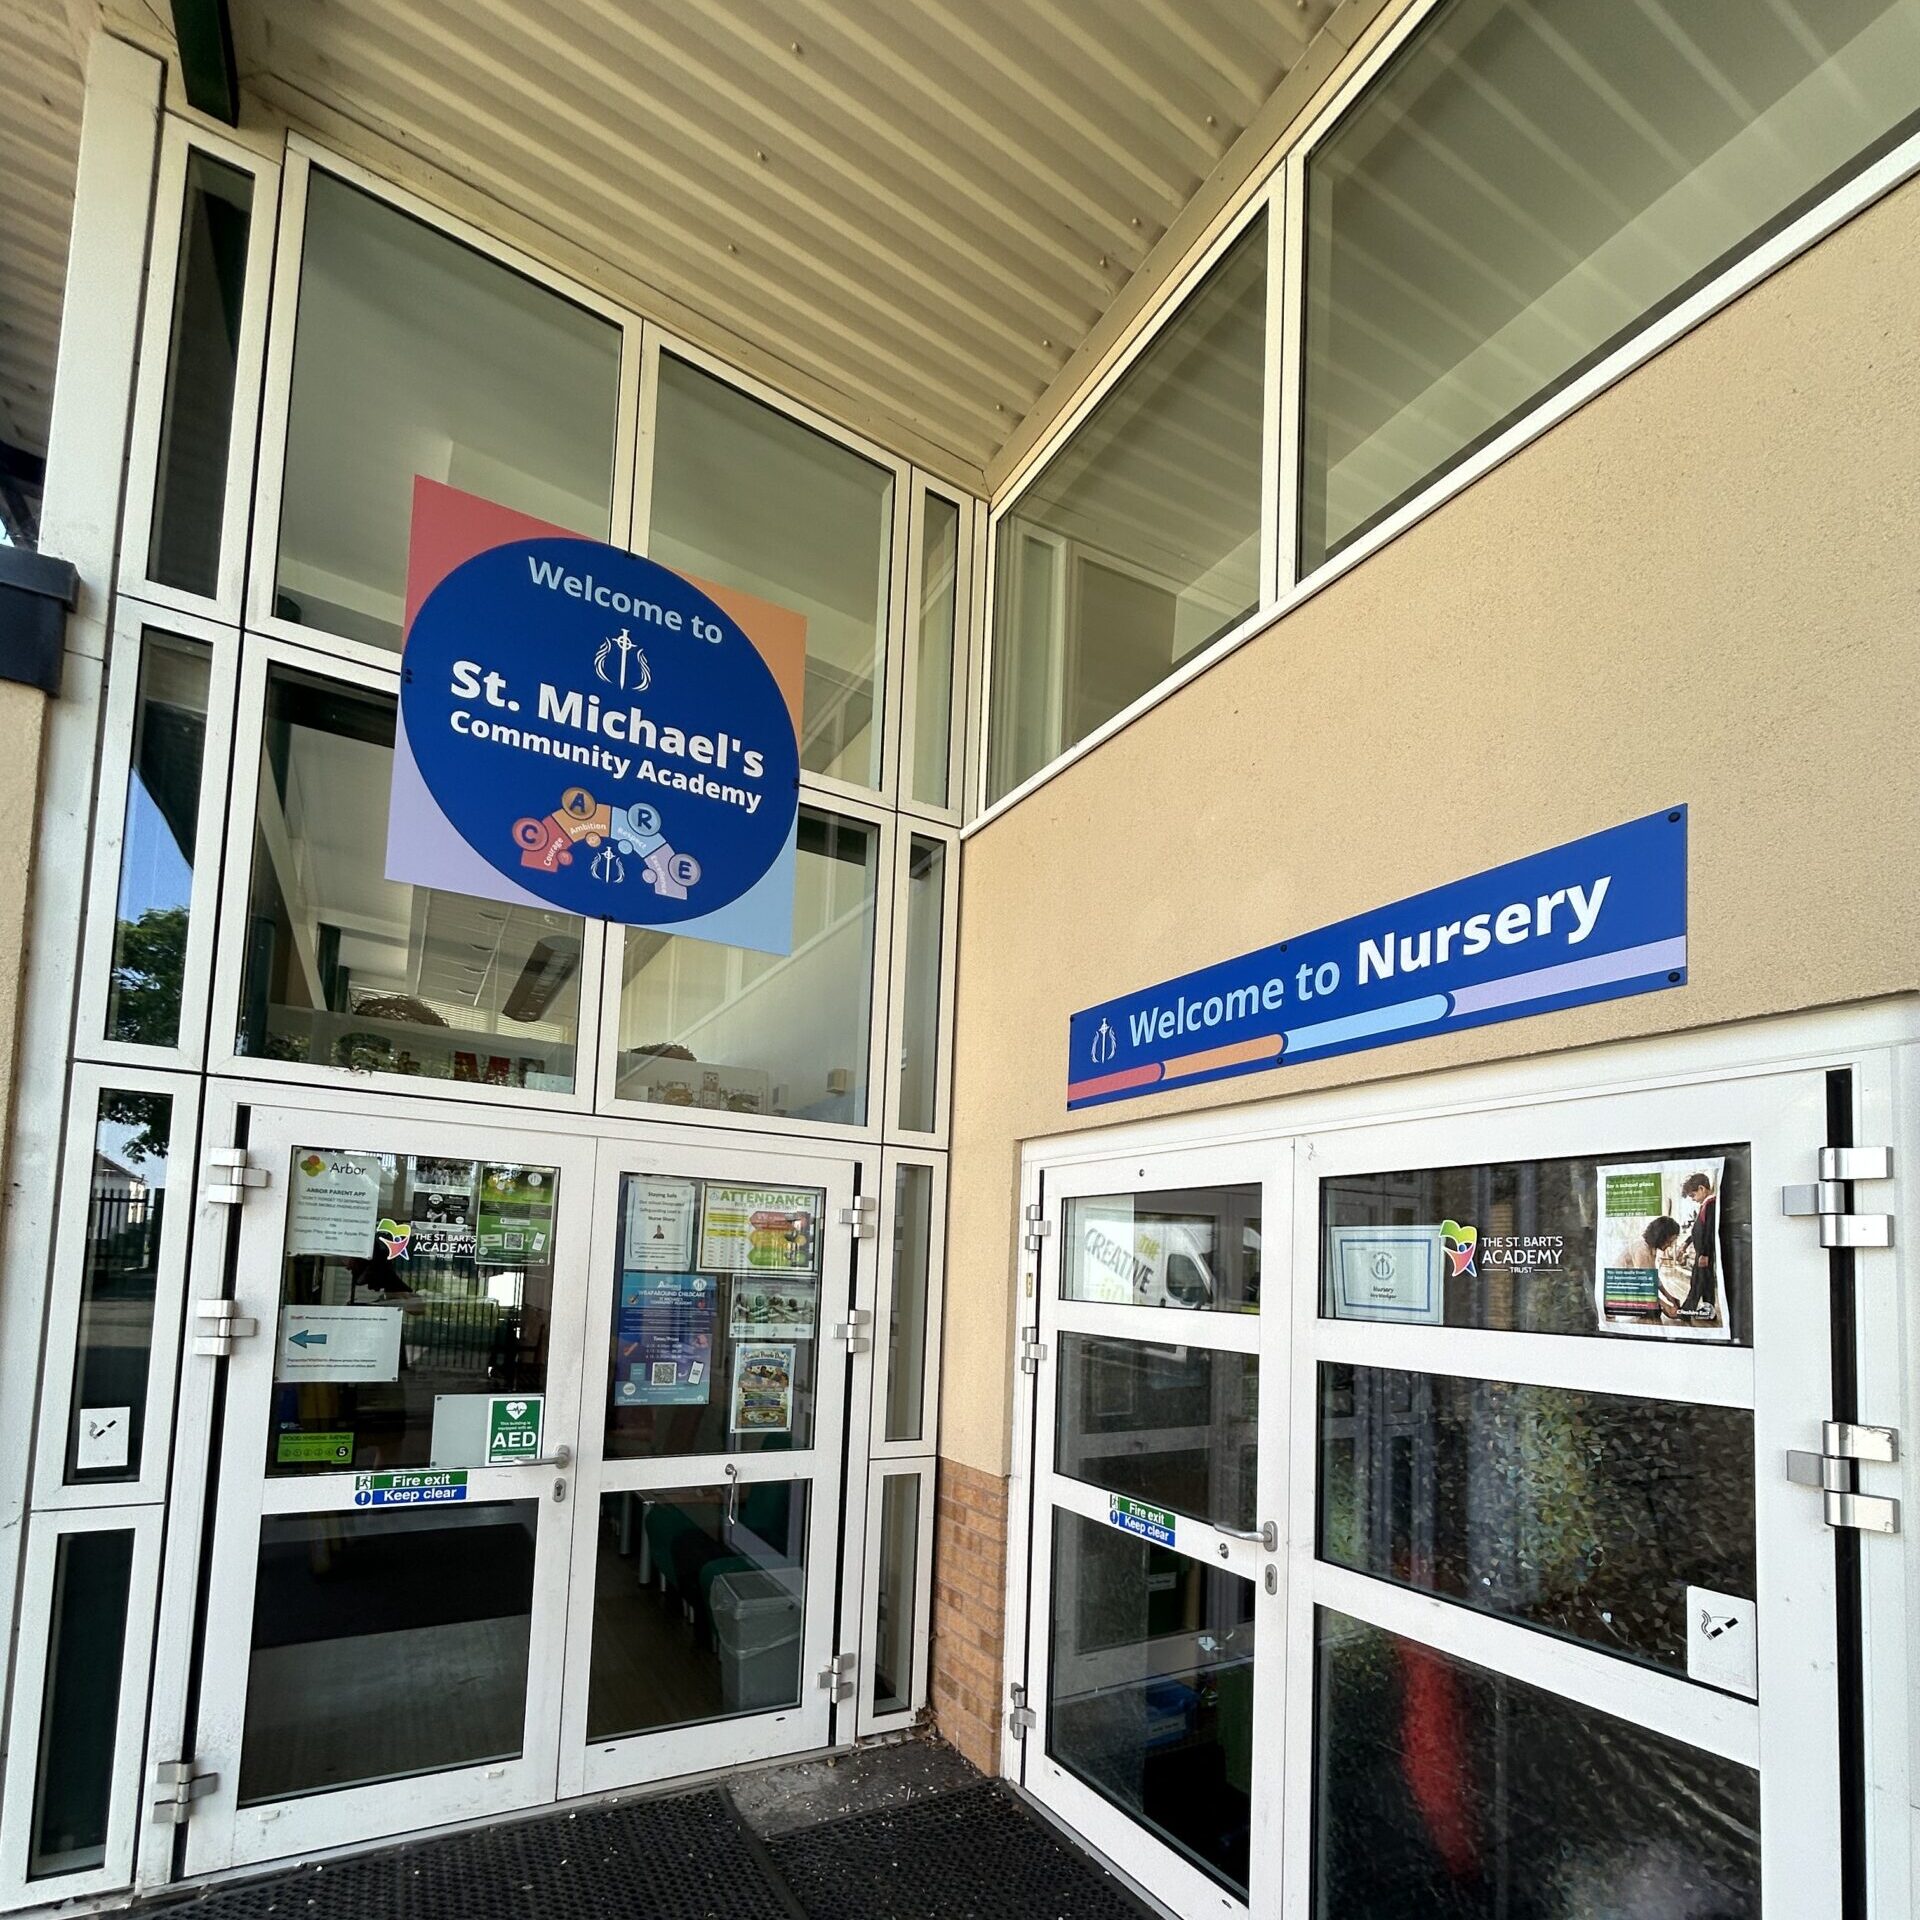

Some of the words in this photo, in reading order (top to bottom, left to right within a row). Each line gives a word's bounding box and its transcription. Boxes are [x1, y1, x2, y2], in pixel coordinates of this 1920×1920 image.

[527, 555, 683, 633] Welcome
[691, 614, 723, 644] to
[450, 660, 520, 712] St.
[538, 682, 765, 779] Michael's
[450, 709, 631, 779] Community
[637, 759, 761, 814] Academy
[569, 822, 607, 834] Ambition
[617, 826, 647, 849] Respect
[543, 837, 564, 867] Courage
[1128, 975, 1284, 1049] Welcome
[1296, 960, 1341, 1002] to
[1358, 876, 1612, 986] Nursery
[329, 1162, 366, 1175] Arbor
[720, 1190, 811, 1207] ATTENDANCE
[415, 1233, 432, 1241] THE
[1481, 1237, 1503, 1247] THE
[1523, 1236, 1563, 1247] BART'S
[413, 1242, 476, 1254] ACADEMY
[1481, 1249, 1563, 1264] ACADEMY
[1084, 1227, 1154, 1294] CREATIVE
[491, 1431, 537, 1449] AED
[338, 1447, 346, 1456] 5
[392, 1475, 420, 1487] Fire
[424, 1473, 450, 1485] exit
[384, 1489, 420, 1502] Keep
[423, 1488, 457, 1499] clear
[1129, 1502, 1146, 1519] Fire
[1147, 1511, 1165, 1525] exit
[1124, 1516, 1146, 1533] Keep
[1147, 1524, 1169, 1541] clear
